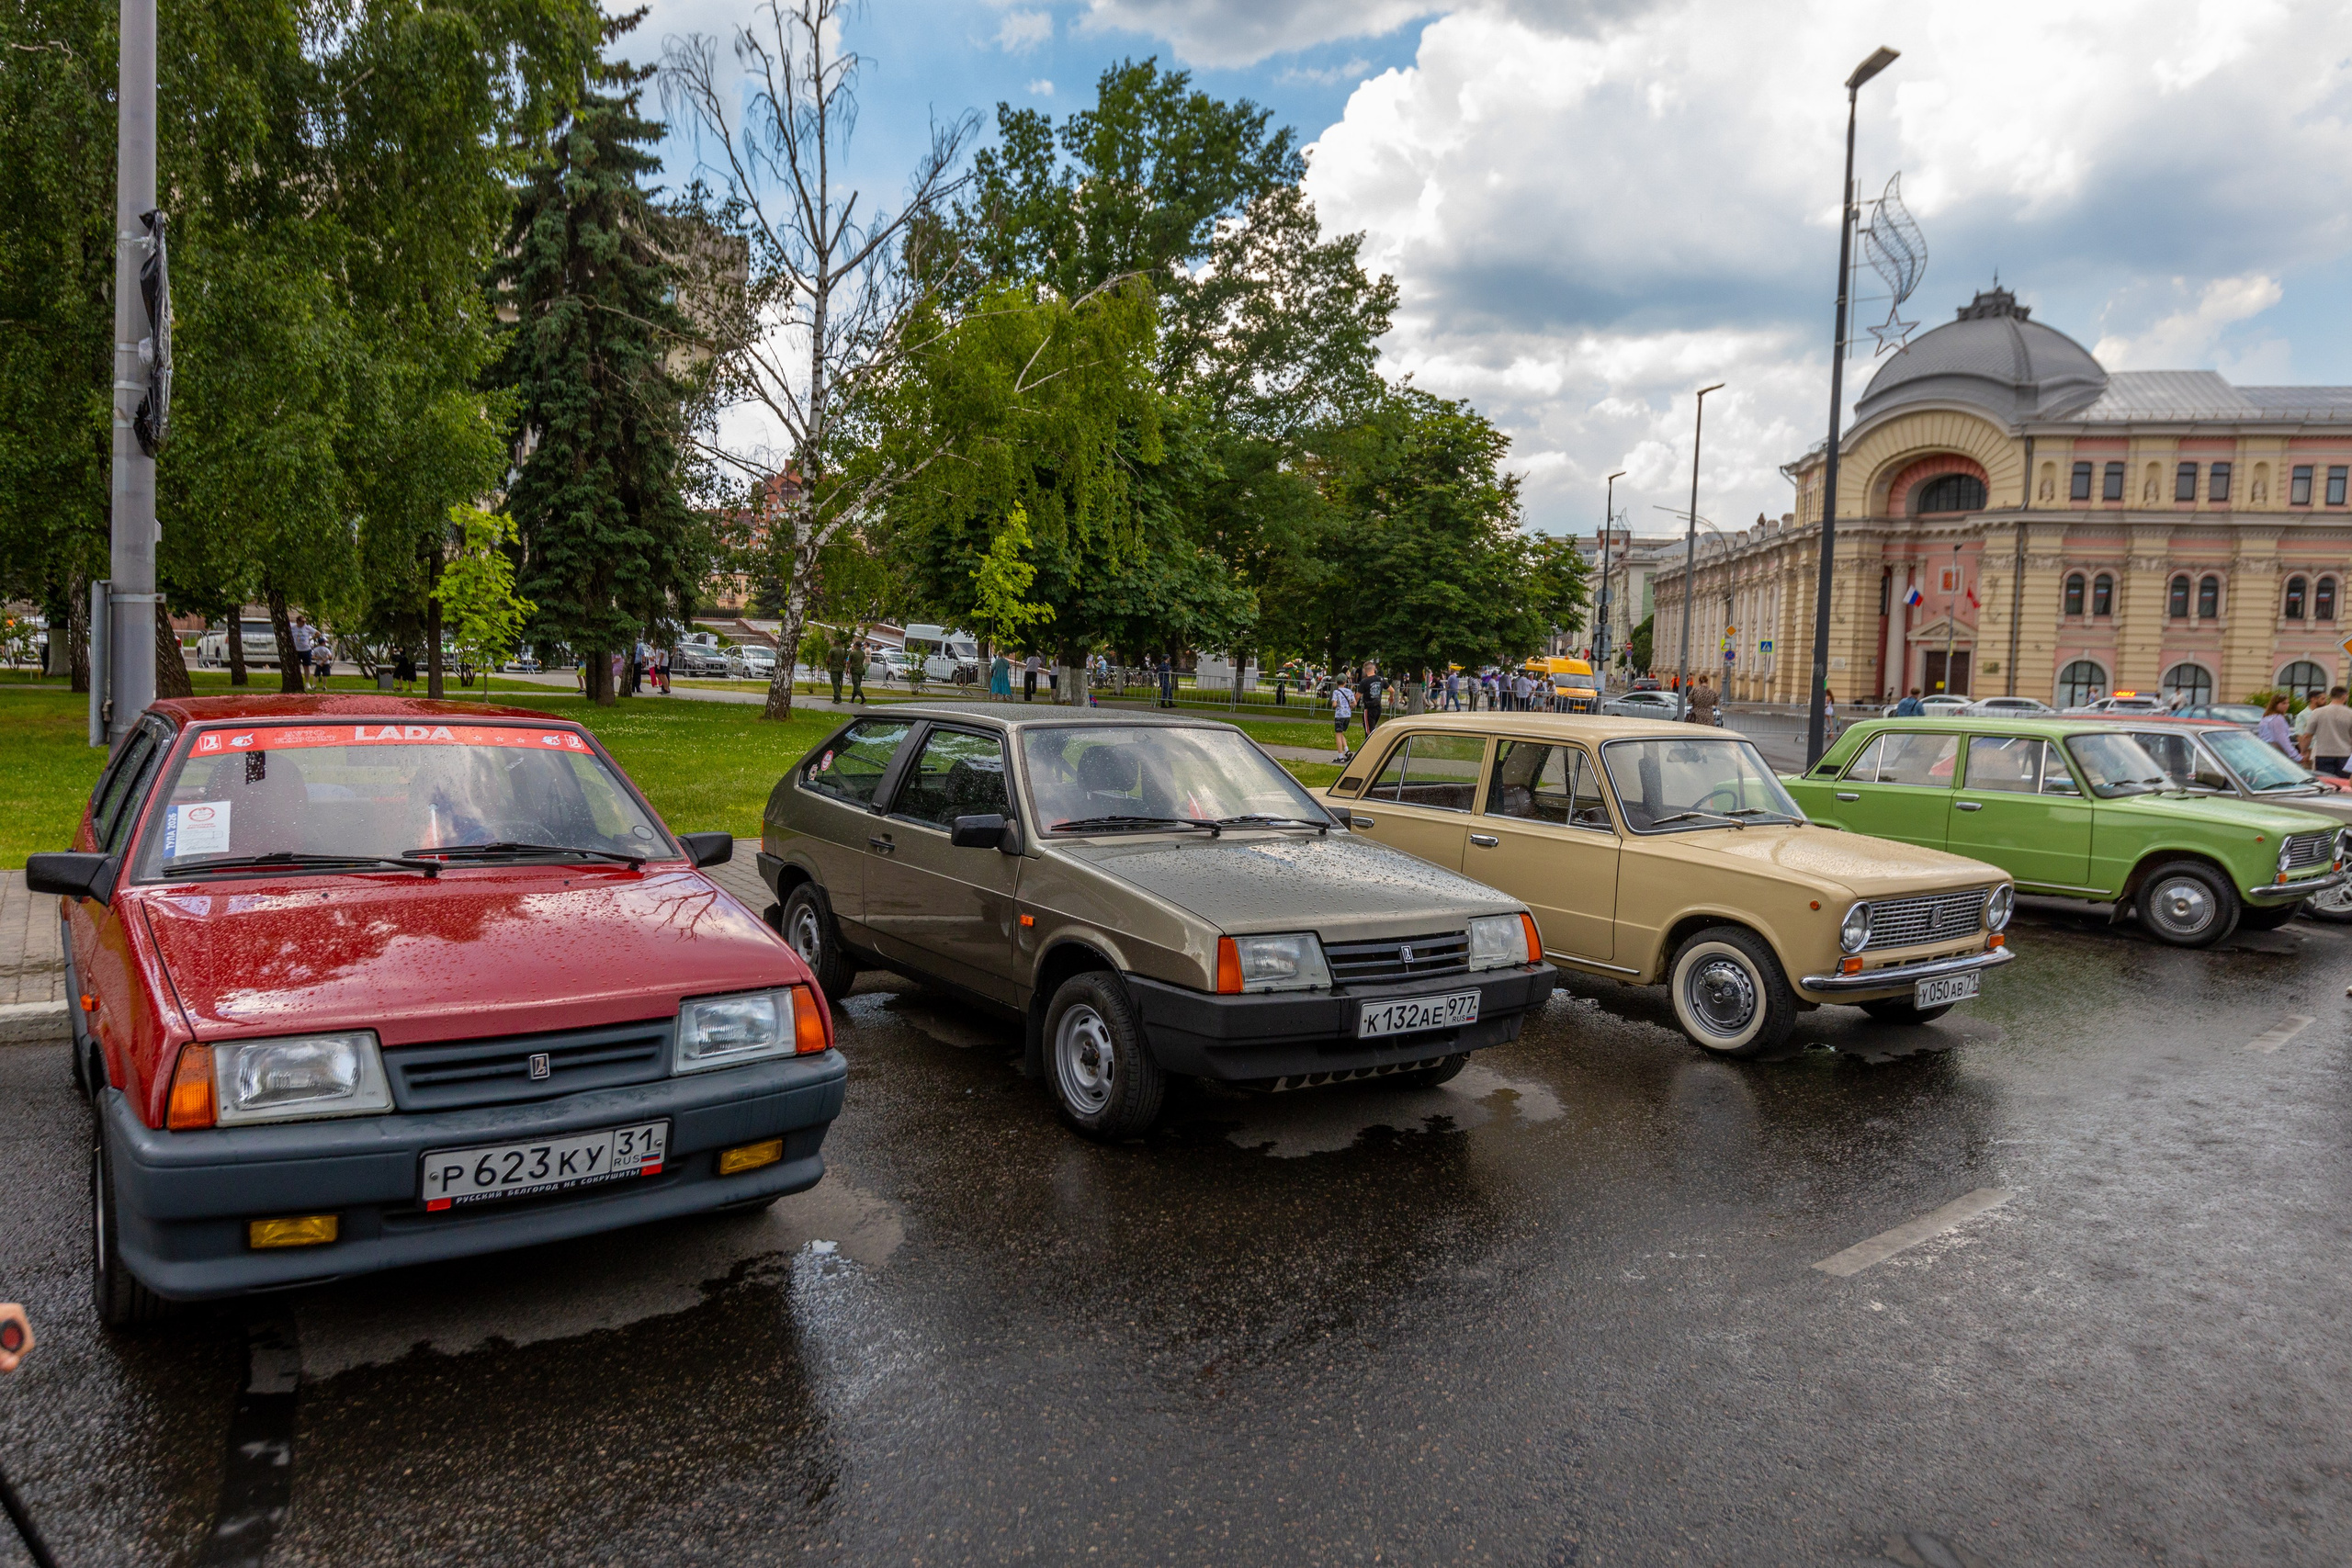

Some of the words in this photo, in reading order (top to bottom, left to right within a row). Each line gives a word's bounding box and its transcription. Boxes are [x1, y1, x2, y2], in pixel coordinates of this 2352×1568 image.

[274, 735, 337, 744] EXPORT
[355, 726, 456, 741] LADA
[1966, 974, 1976, 989] 71
[1366, 1004, 1443, 1033] К132АЕ
[1448, 995, 1476, 1017] 977
[1452, 1014, 1466, 1022] RUS
[442, 1145, 605, 1192] Р623КУ
[617, 1127, 653, 1156] 31
[614, 1154, 640, 1168] RUS
[456, 1190, 503, 1205] РУССКИЙ
[507, 1183, 559, 1197] БЕЛГОРОД
[563, 1179, 576, 1188] НЕ
